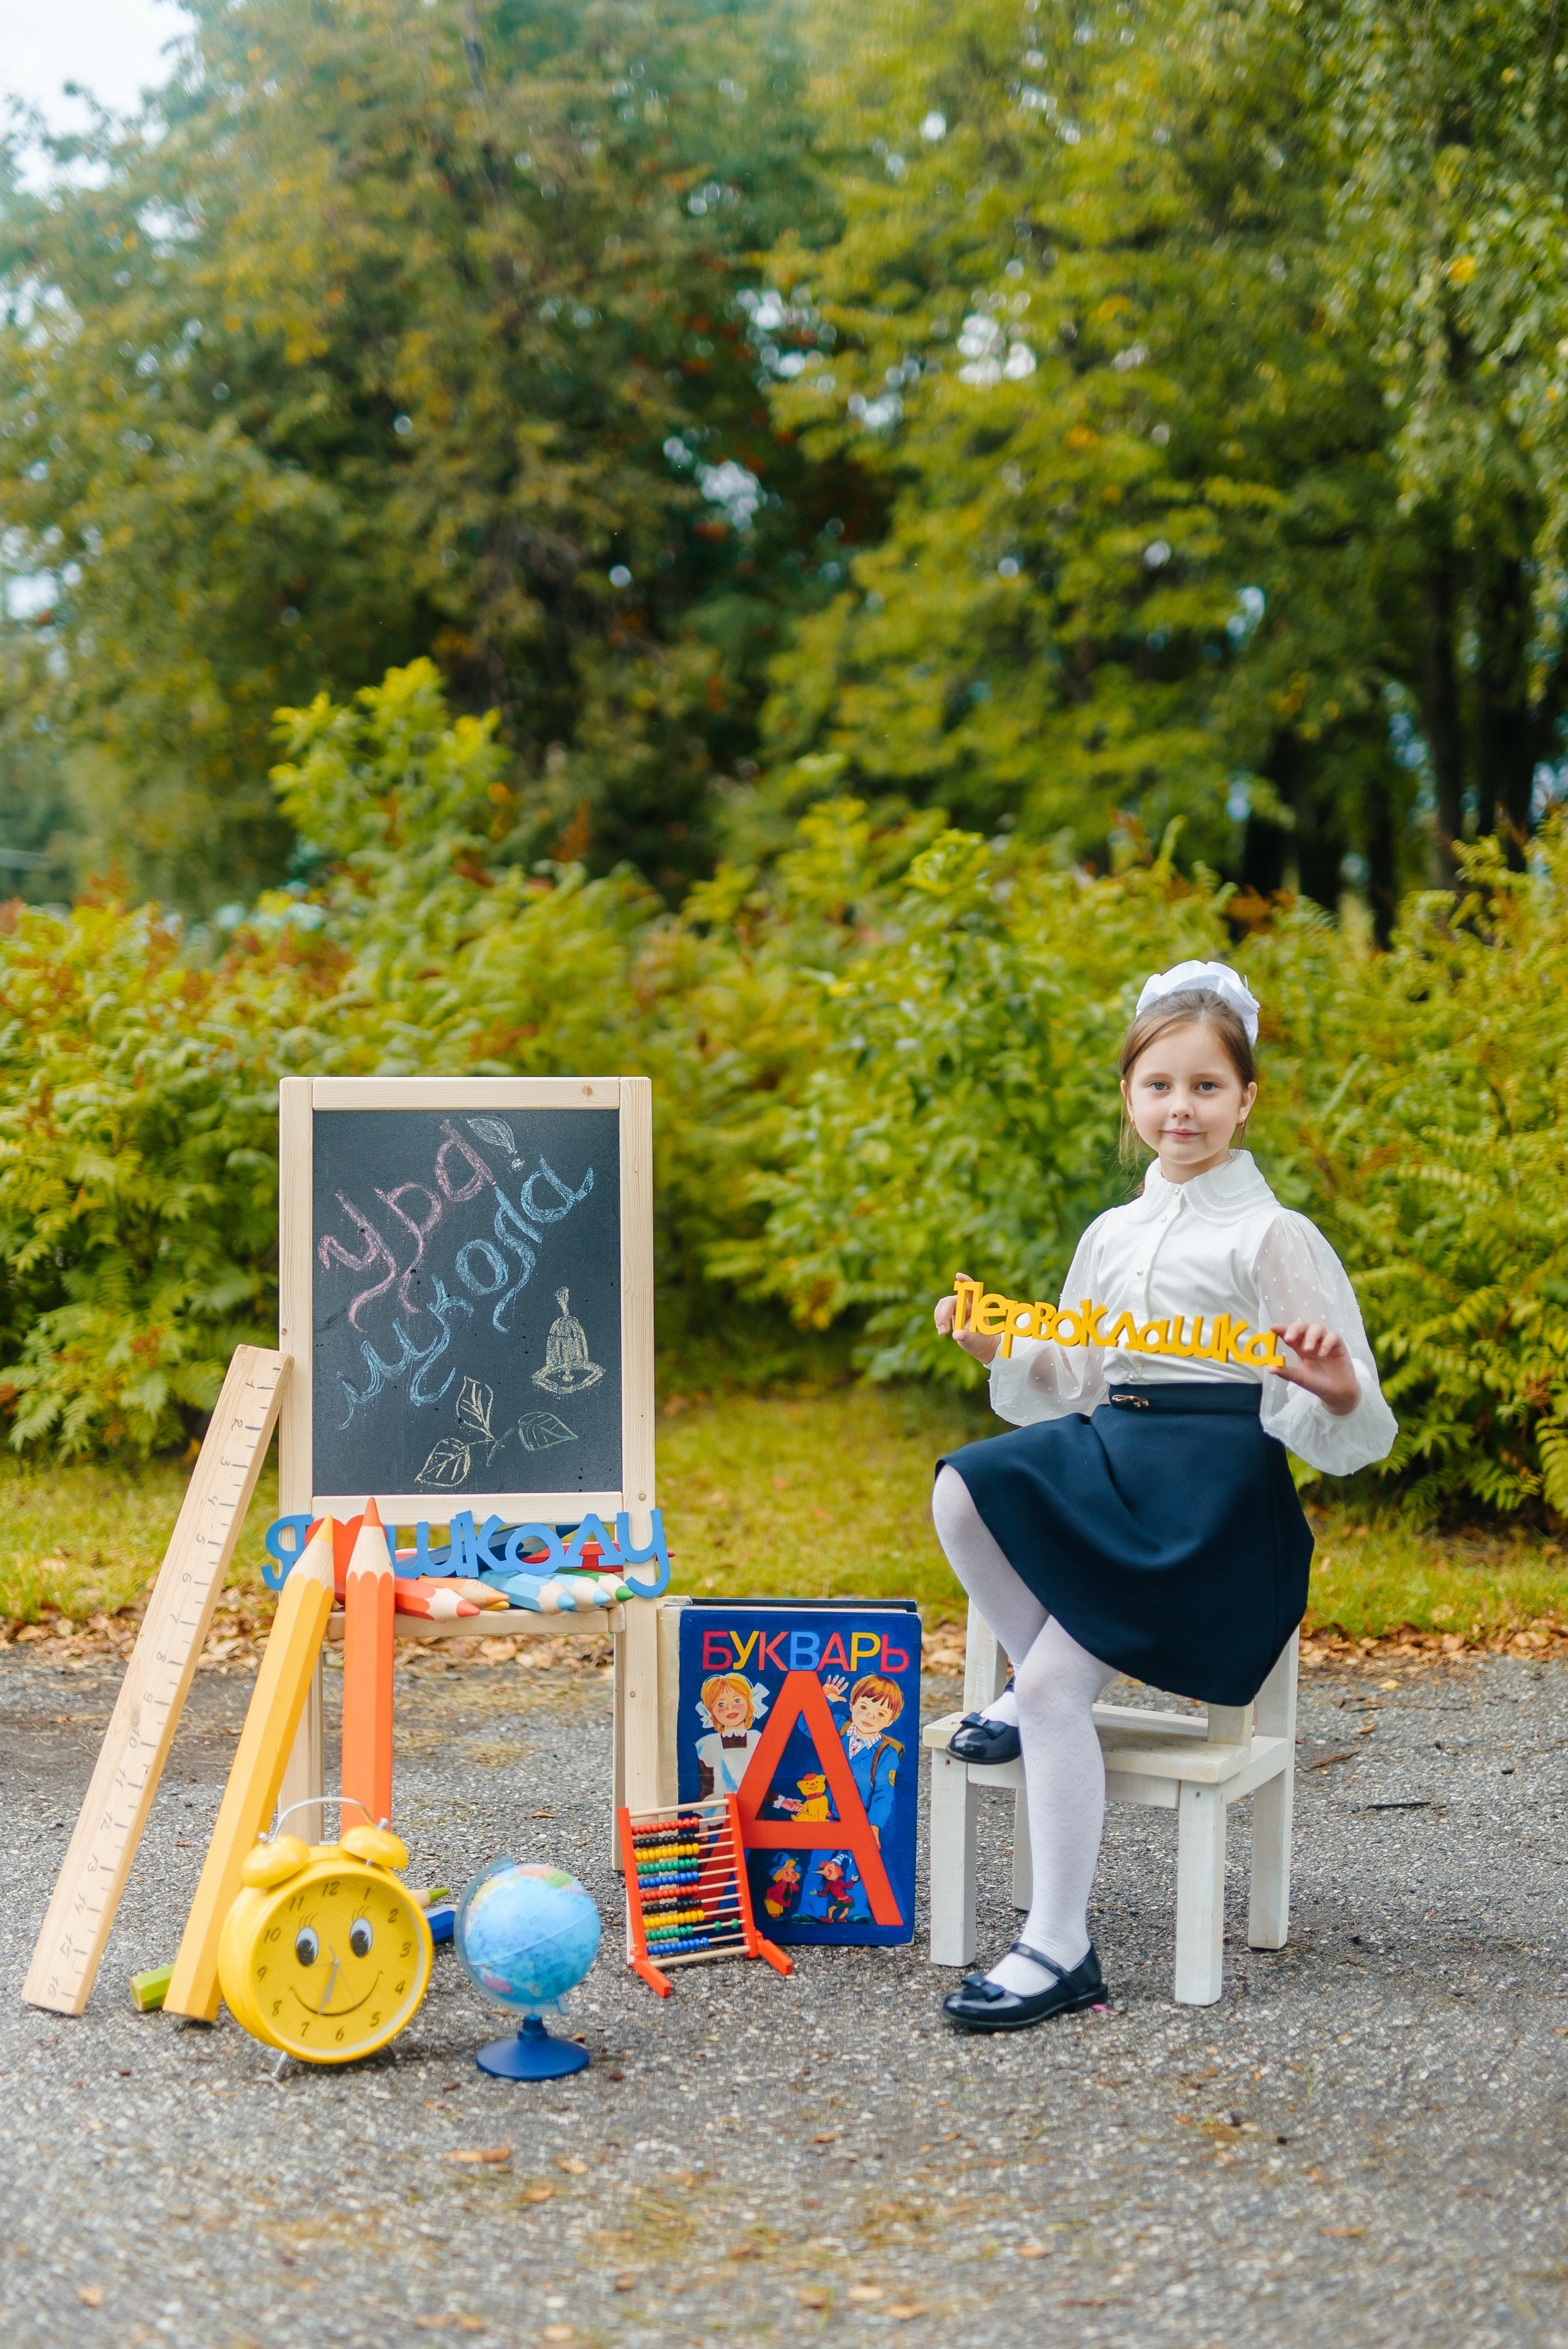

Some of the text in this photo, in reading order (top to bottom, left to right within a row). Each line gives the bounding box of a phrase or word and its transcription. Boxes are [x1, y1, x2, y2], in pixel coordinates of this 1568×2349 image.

[953, 1280, 1284, 1367] Первоклашка
[245, 1379, 255, 1389] 1
[231, 1418, 243, 1431] 2
[220, 1456, 230, 1466] 3
[208, 1496, 218, 1506] 4
[196, 1532, 205, 1546] 5
[262, 1514, 312, 1591] Я
[182, 1572, 192, 1583] 6
[170, 1613, 180, 1623] 7
[156, 1651, 166, 1662] 8
[702, 1631, 910, 1673] БУКВАРЬ
[143, 1691, 153, 1703] 9
[129, 1730, 141, 1748] 10
[115, 1767, 126, 1789] 11
[100, 1811, 113, 1831] 12
[87, 1853, 99, 1872] 13
[322, 1881, 340, 1898] 12
[364, 1887, 371, 1901] 1
[74, 1892, 86, 1915] 14
[289, 1896, 304, 1912] 11
[388, 1908, 398, 1923] 2
[263, 1928, 281, 1944] 10
[59, 1933, 74, 1958] 15
[400, 1941, 412, 1958] 3
[257, 1966, 267, 1983] 9
[47, 1975, 59, 1999] 16
[395, 1980, 405, 1995] 4
[271, 2000, 282, 2016] 8
[370, 2012, 381, 2027] 5
[301, 2022, 310, 2037] 7
[335, 2027, 344, 2042] 6
